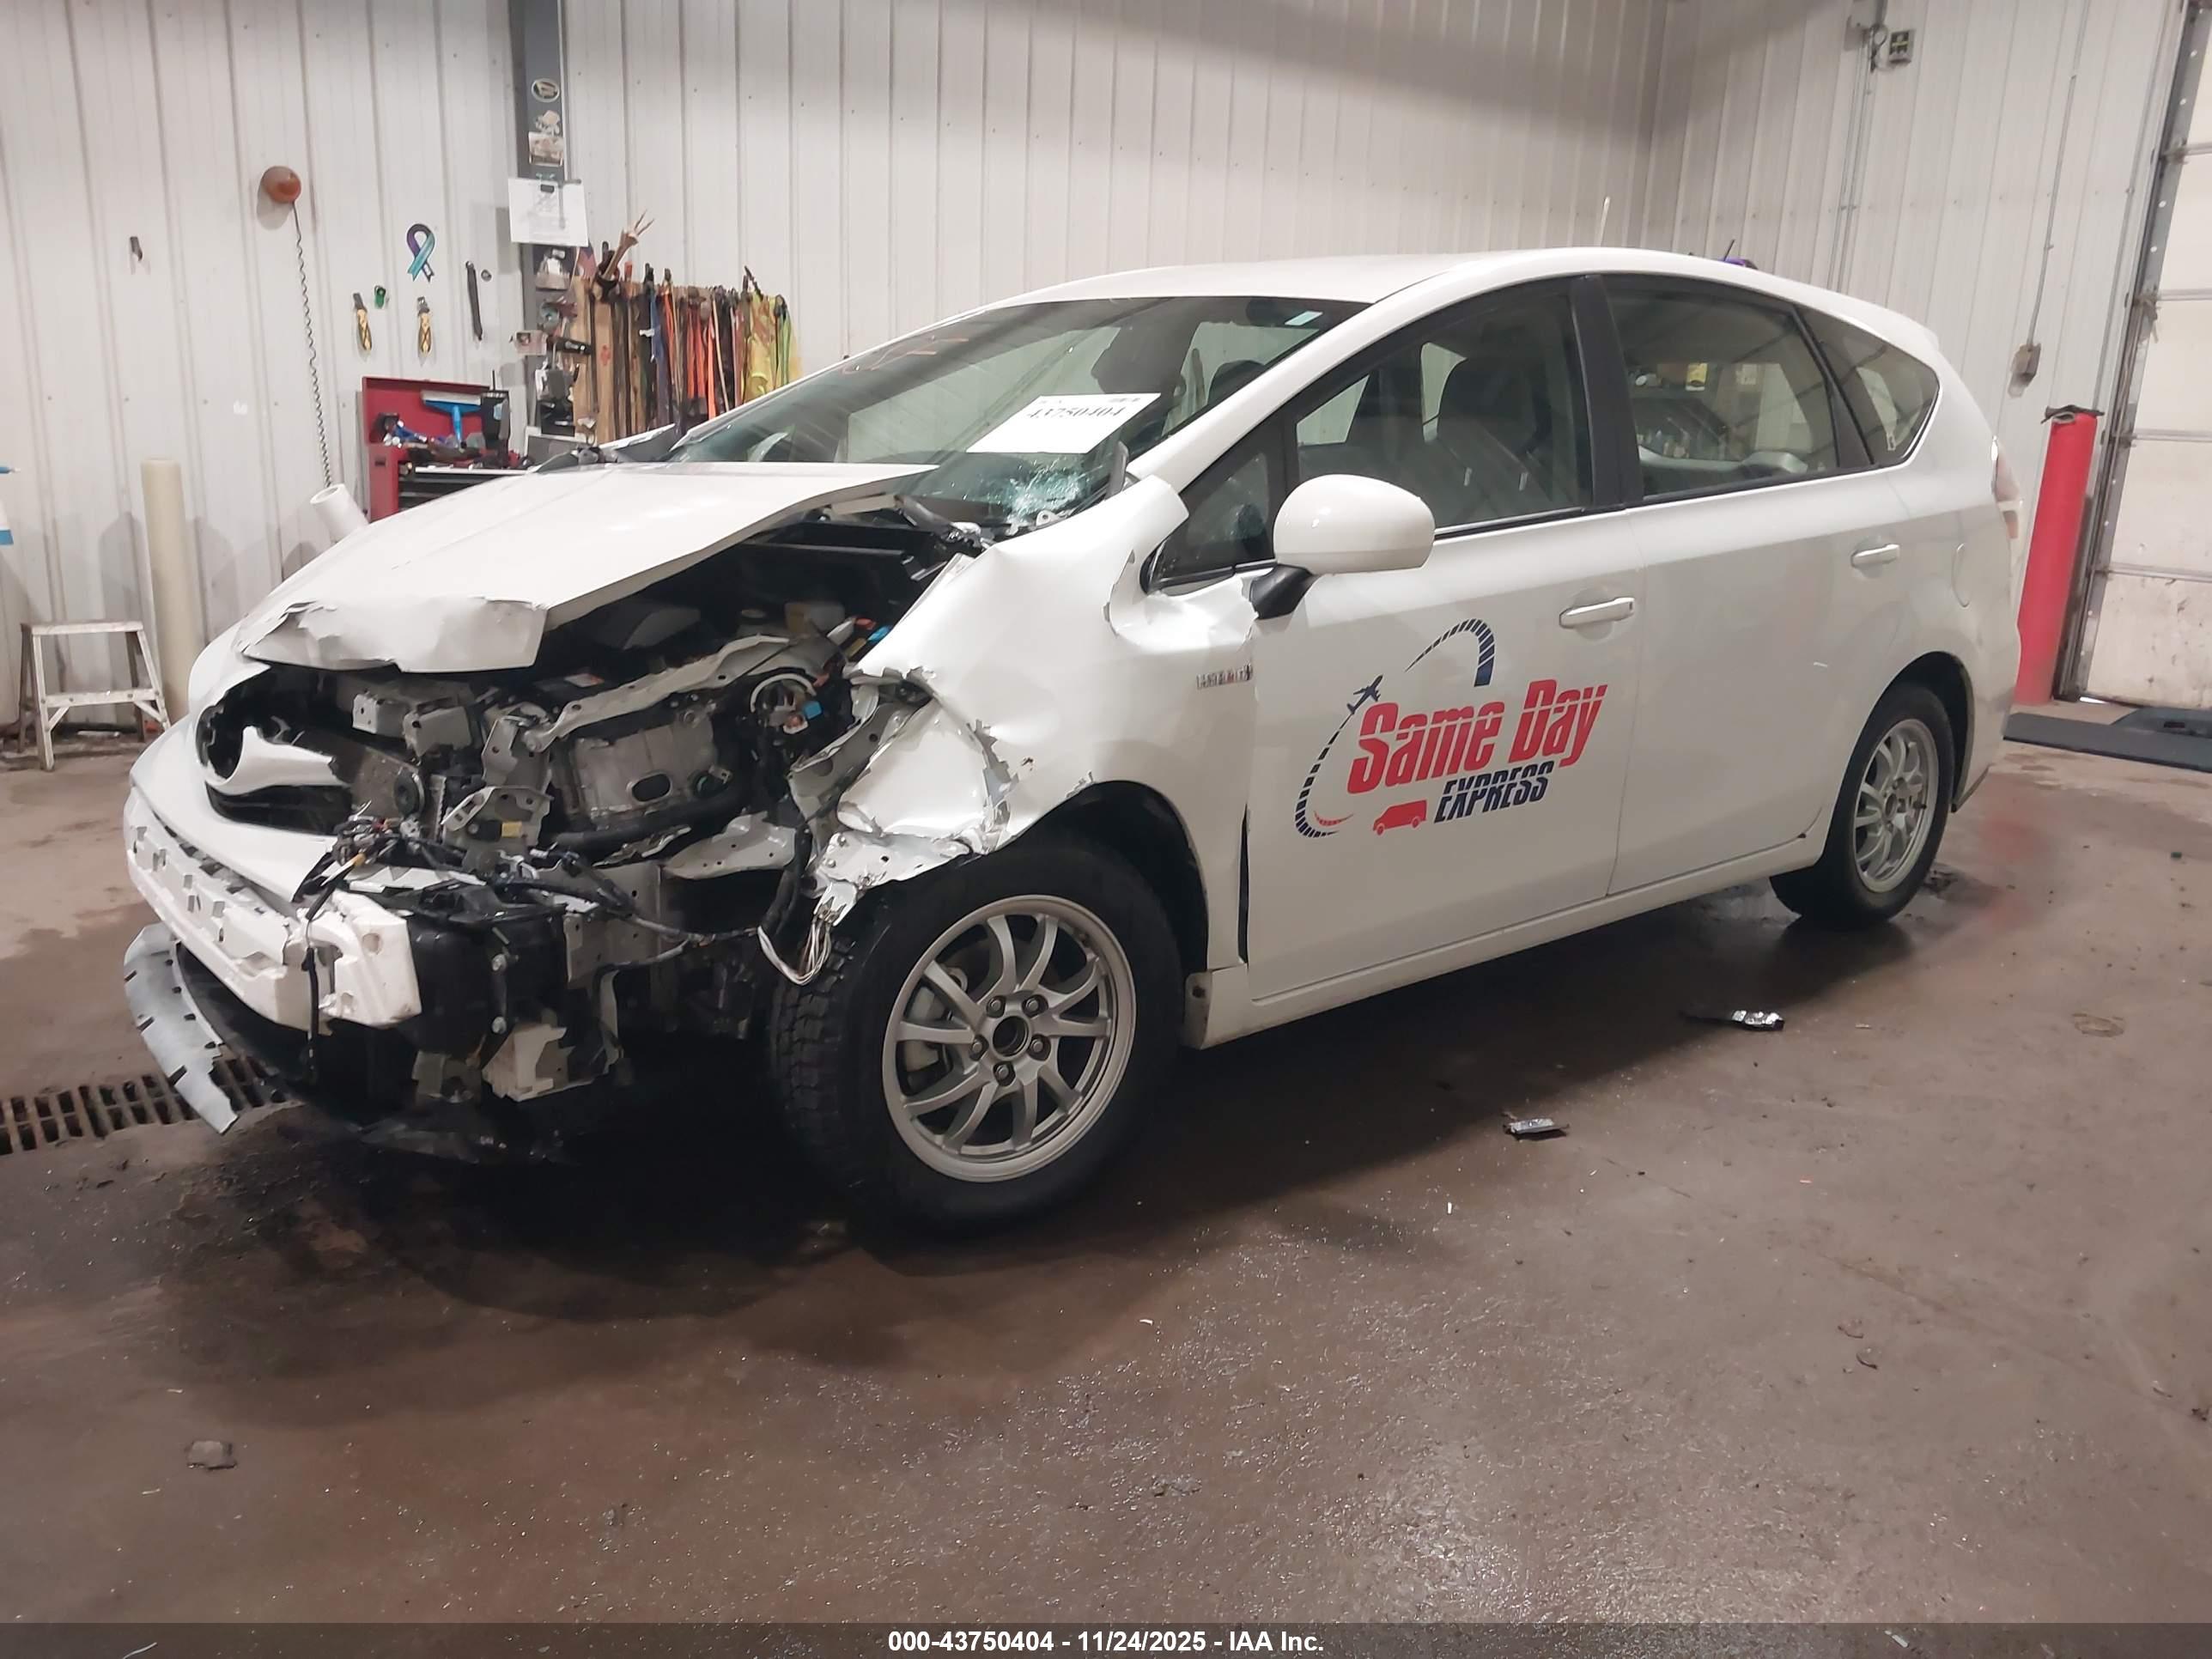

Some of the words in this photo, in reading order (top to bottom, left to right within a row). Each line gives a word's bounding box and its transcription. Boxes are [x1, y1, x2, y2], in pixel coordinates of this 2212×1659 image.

[1346, 702, 1505, 794] Same
[1508, 679, 1608, 767] Day
[1433, 760, 1555, 823] EXPRESS
